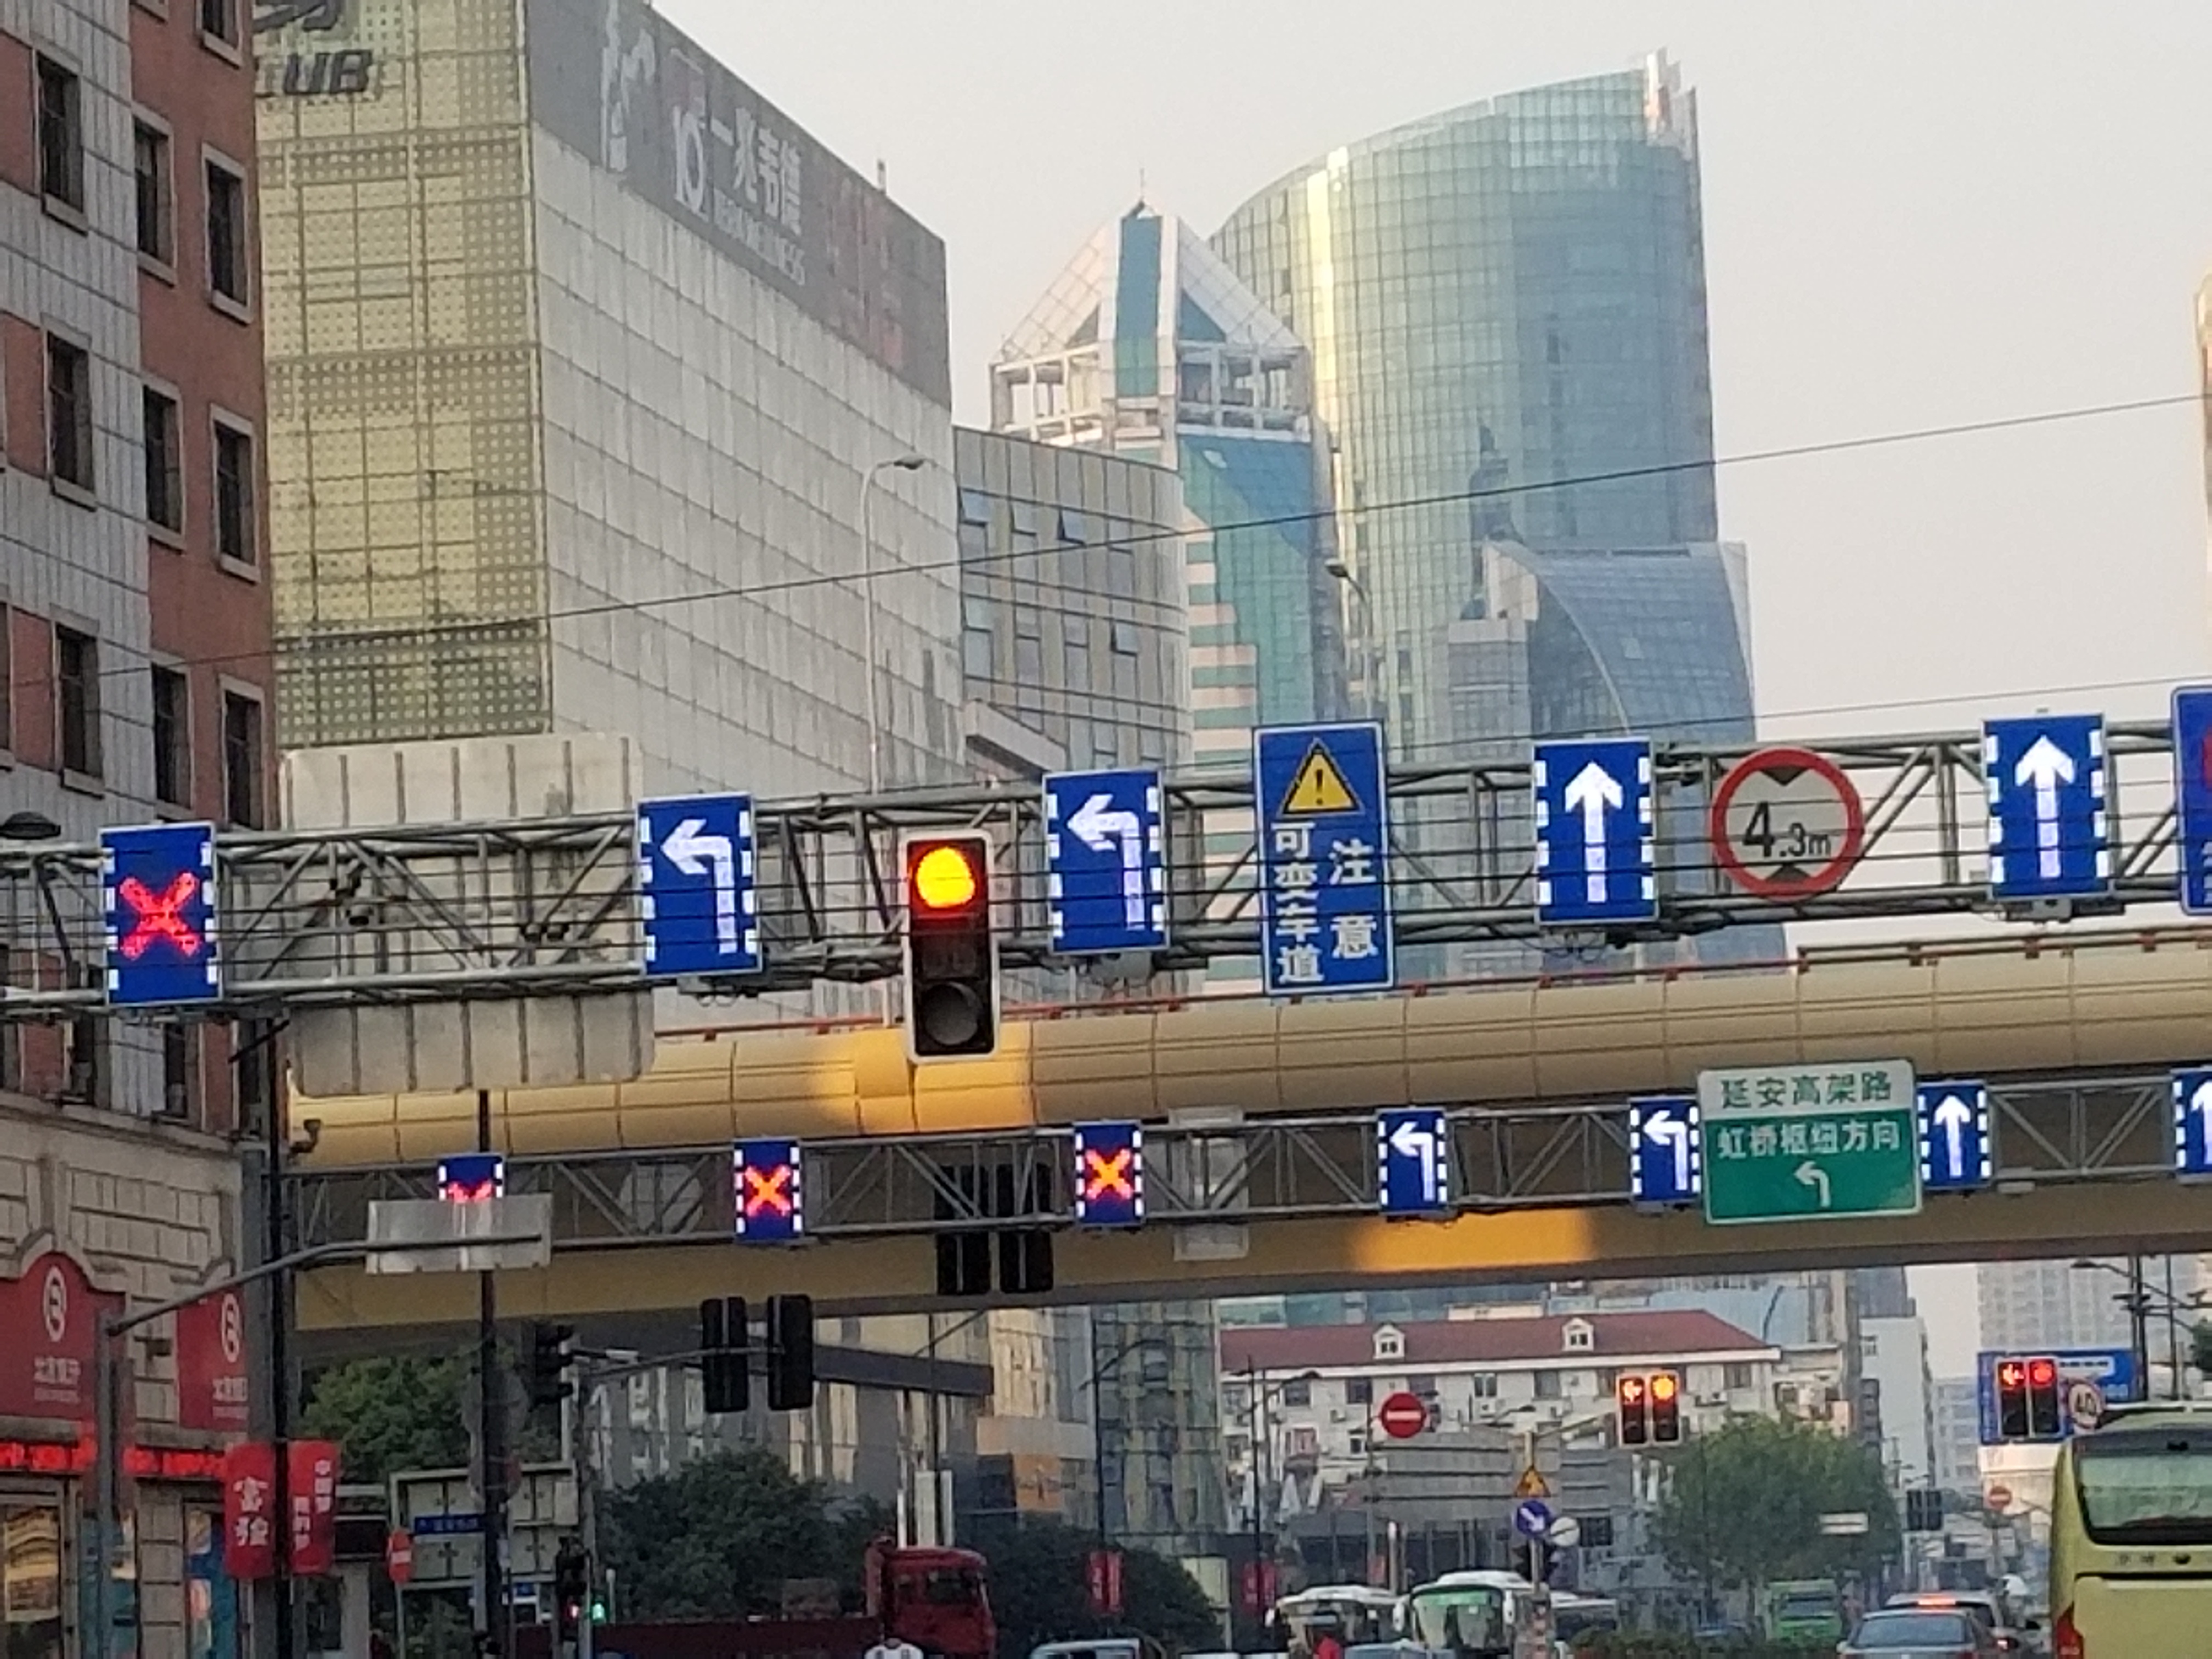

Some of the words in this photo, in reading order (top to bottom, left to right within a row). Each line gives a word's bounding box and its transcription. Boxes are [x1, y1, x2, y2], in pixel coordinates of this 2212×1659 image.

[1742, 801, 1832, 859] 4.3m
[1271, 822, 1324, 984] 可变车道
[1328, 838, 1379, 959] 注意
[1720, 1071, 1892, 1109] 延安高架路
[1717, 1119, 1900, 1160] 虹桥枢纽方向
